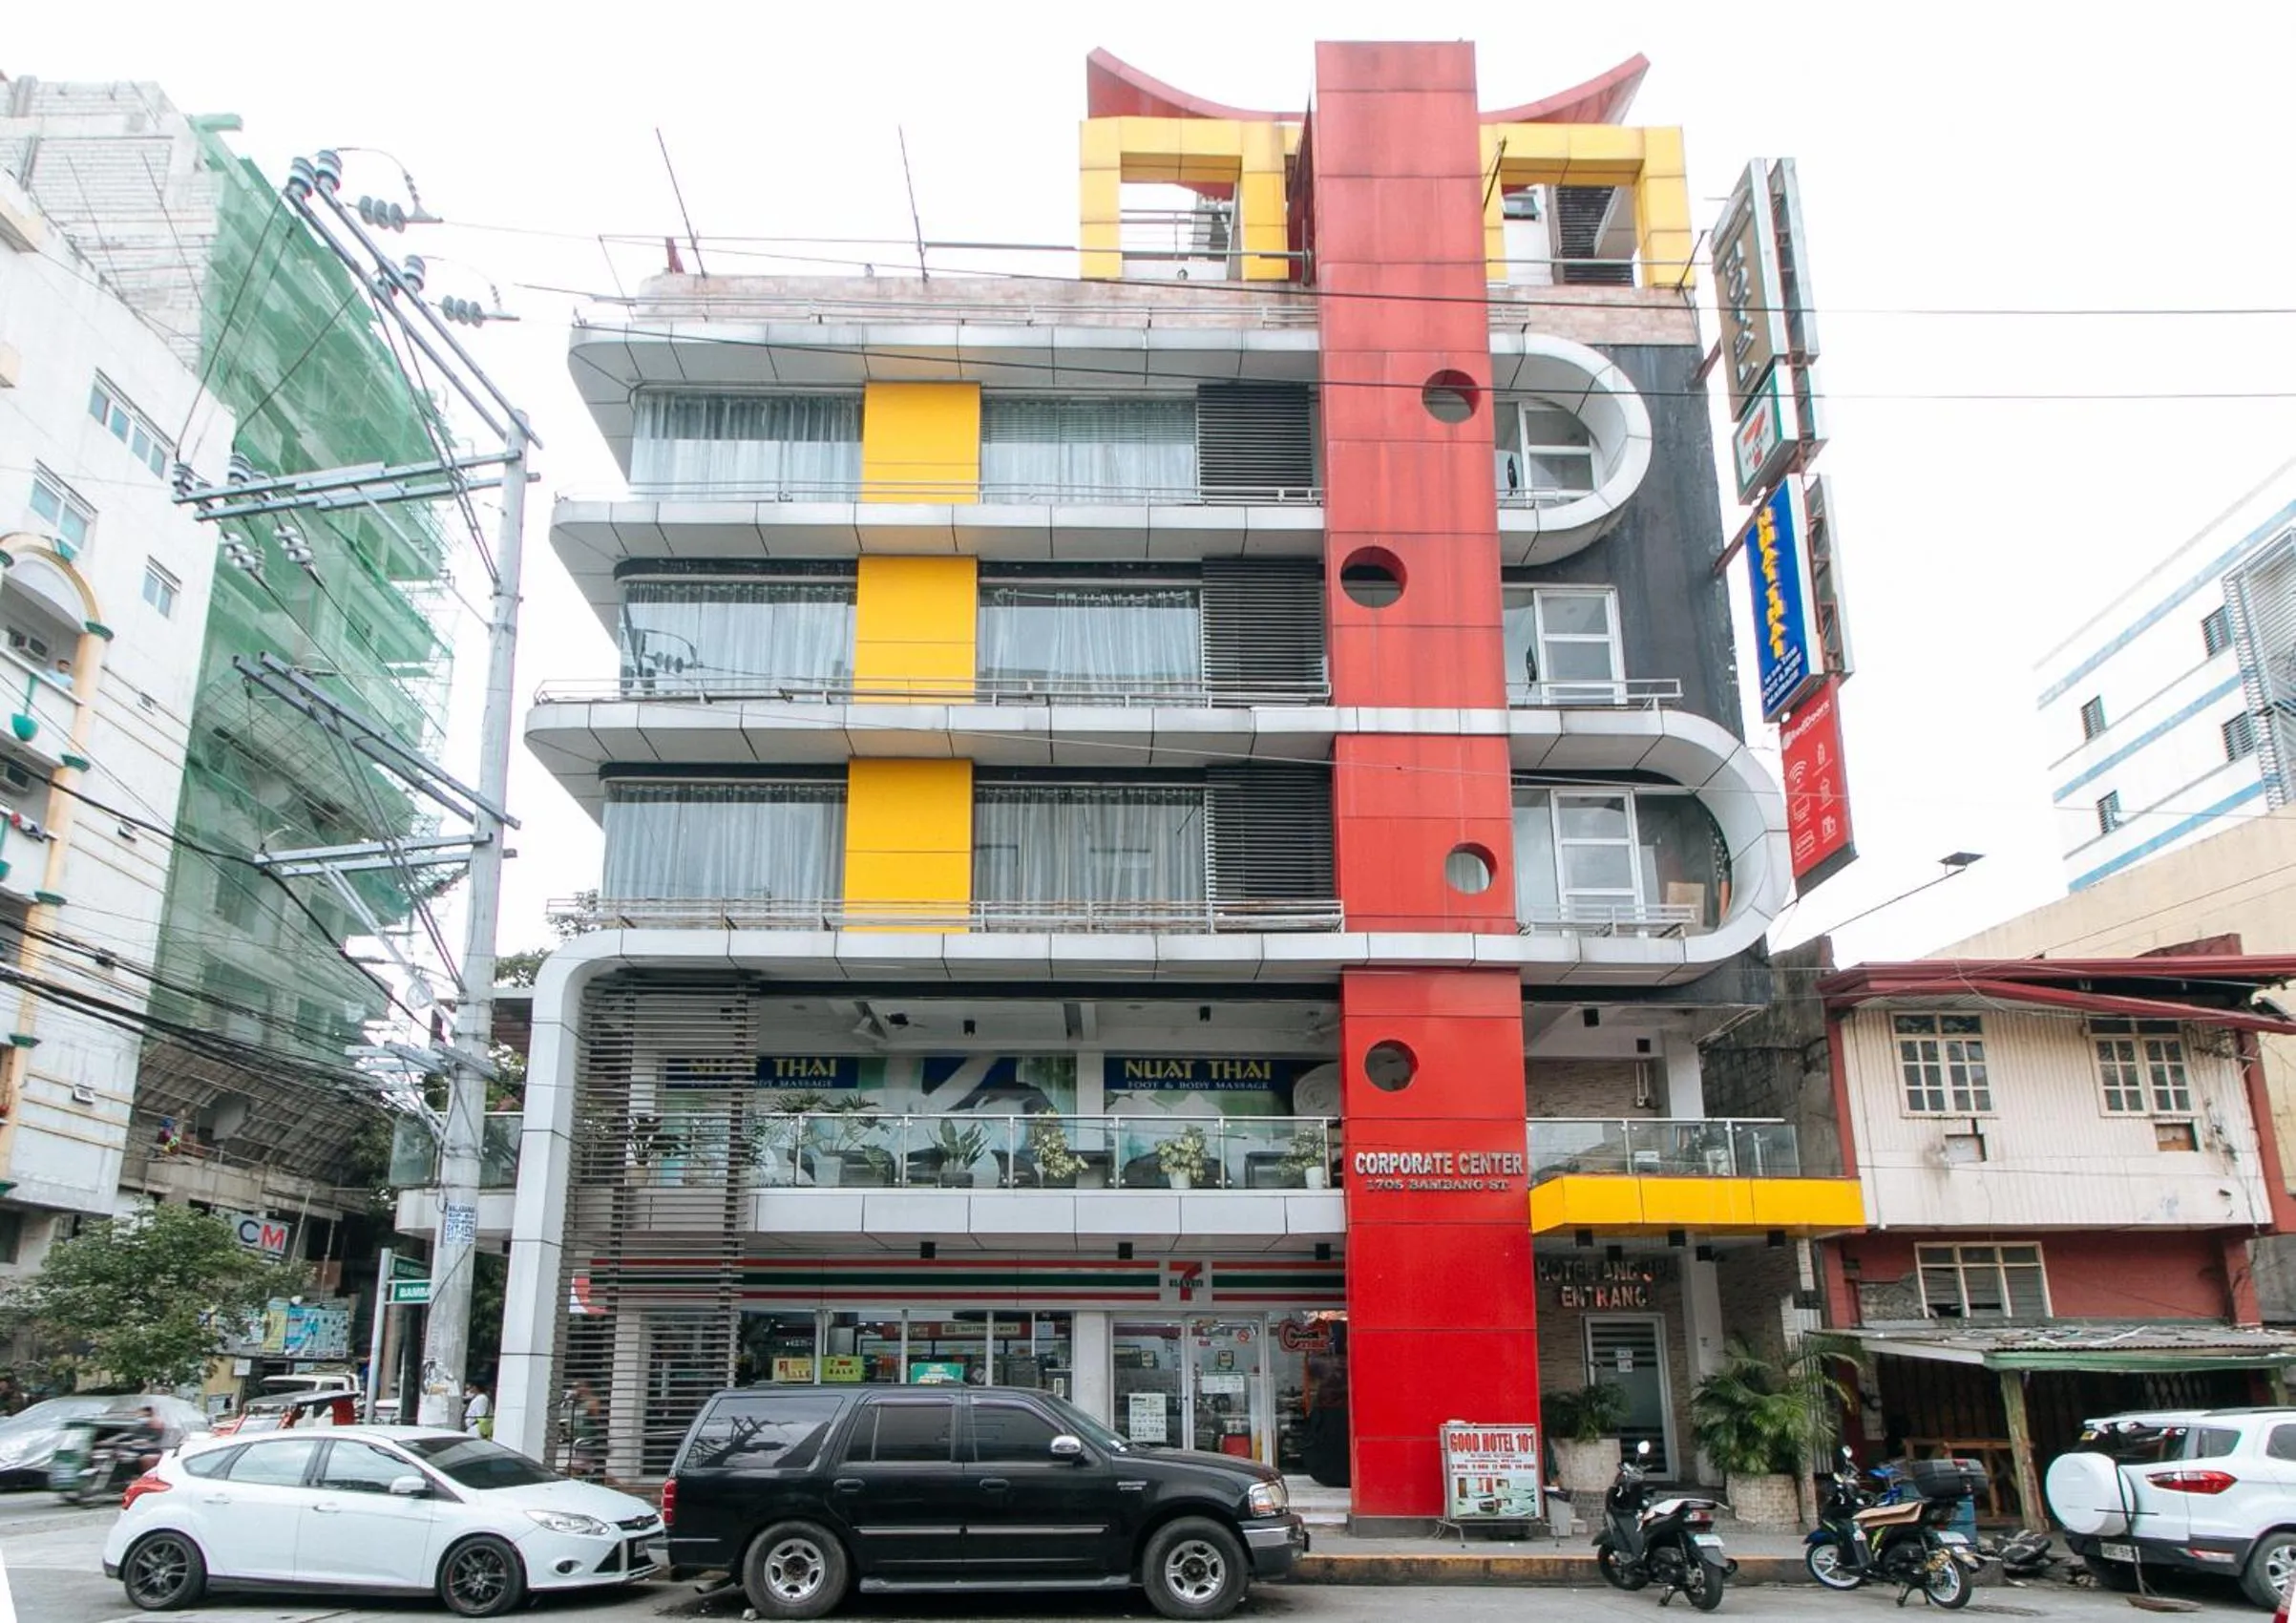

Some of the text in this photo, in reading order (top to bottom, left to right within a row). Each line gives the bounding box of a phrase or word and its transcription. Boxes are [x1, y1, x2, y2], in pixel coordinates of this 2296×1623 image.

[773, 1058, 837, 1077] THAI
[1125, 1061, 1271, 1080] NUAT THAI
[1127, 1081, 1158, 1089] FOOT
[1179, 1081, 1210, 1089] BODY
[1215, 1081, 1269, 1089] MASSAGE
[1355, 1151, 1524, 1176] CORPORATE CENTER
[1408, 1179, 1484, 1191] BAMBANG
[238, 1219, 285, 1252] CM
[1169, 1261, 1203, 1301] 7
[1561, 1285, 1655, 1309] ENTRANC
[1450, 1433, 1534, 1452] GOOD HOTEL 101
